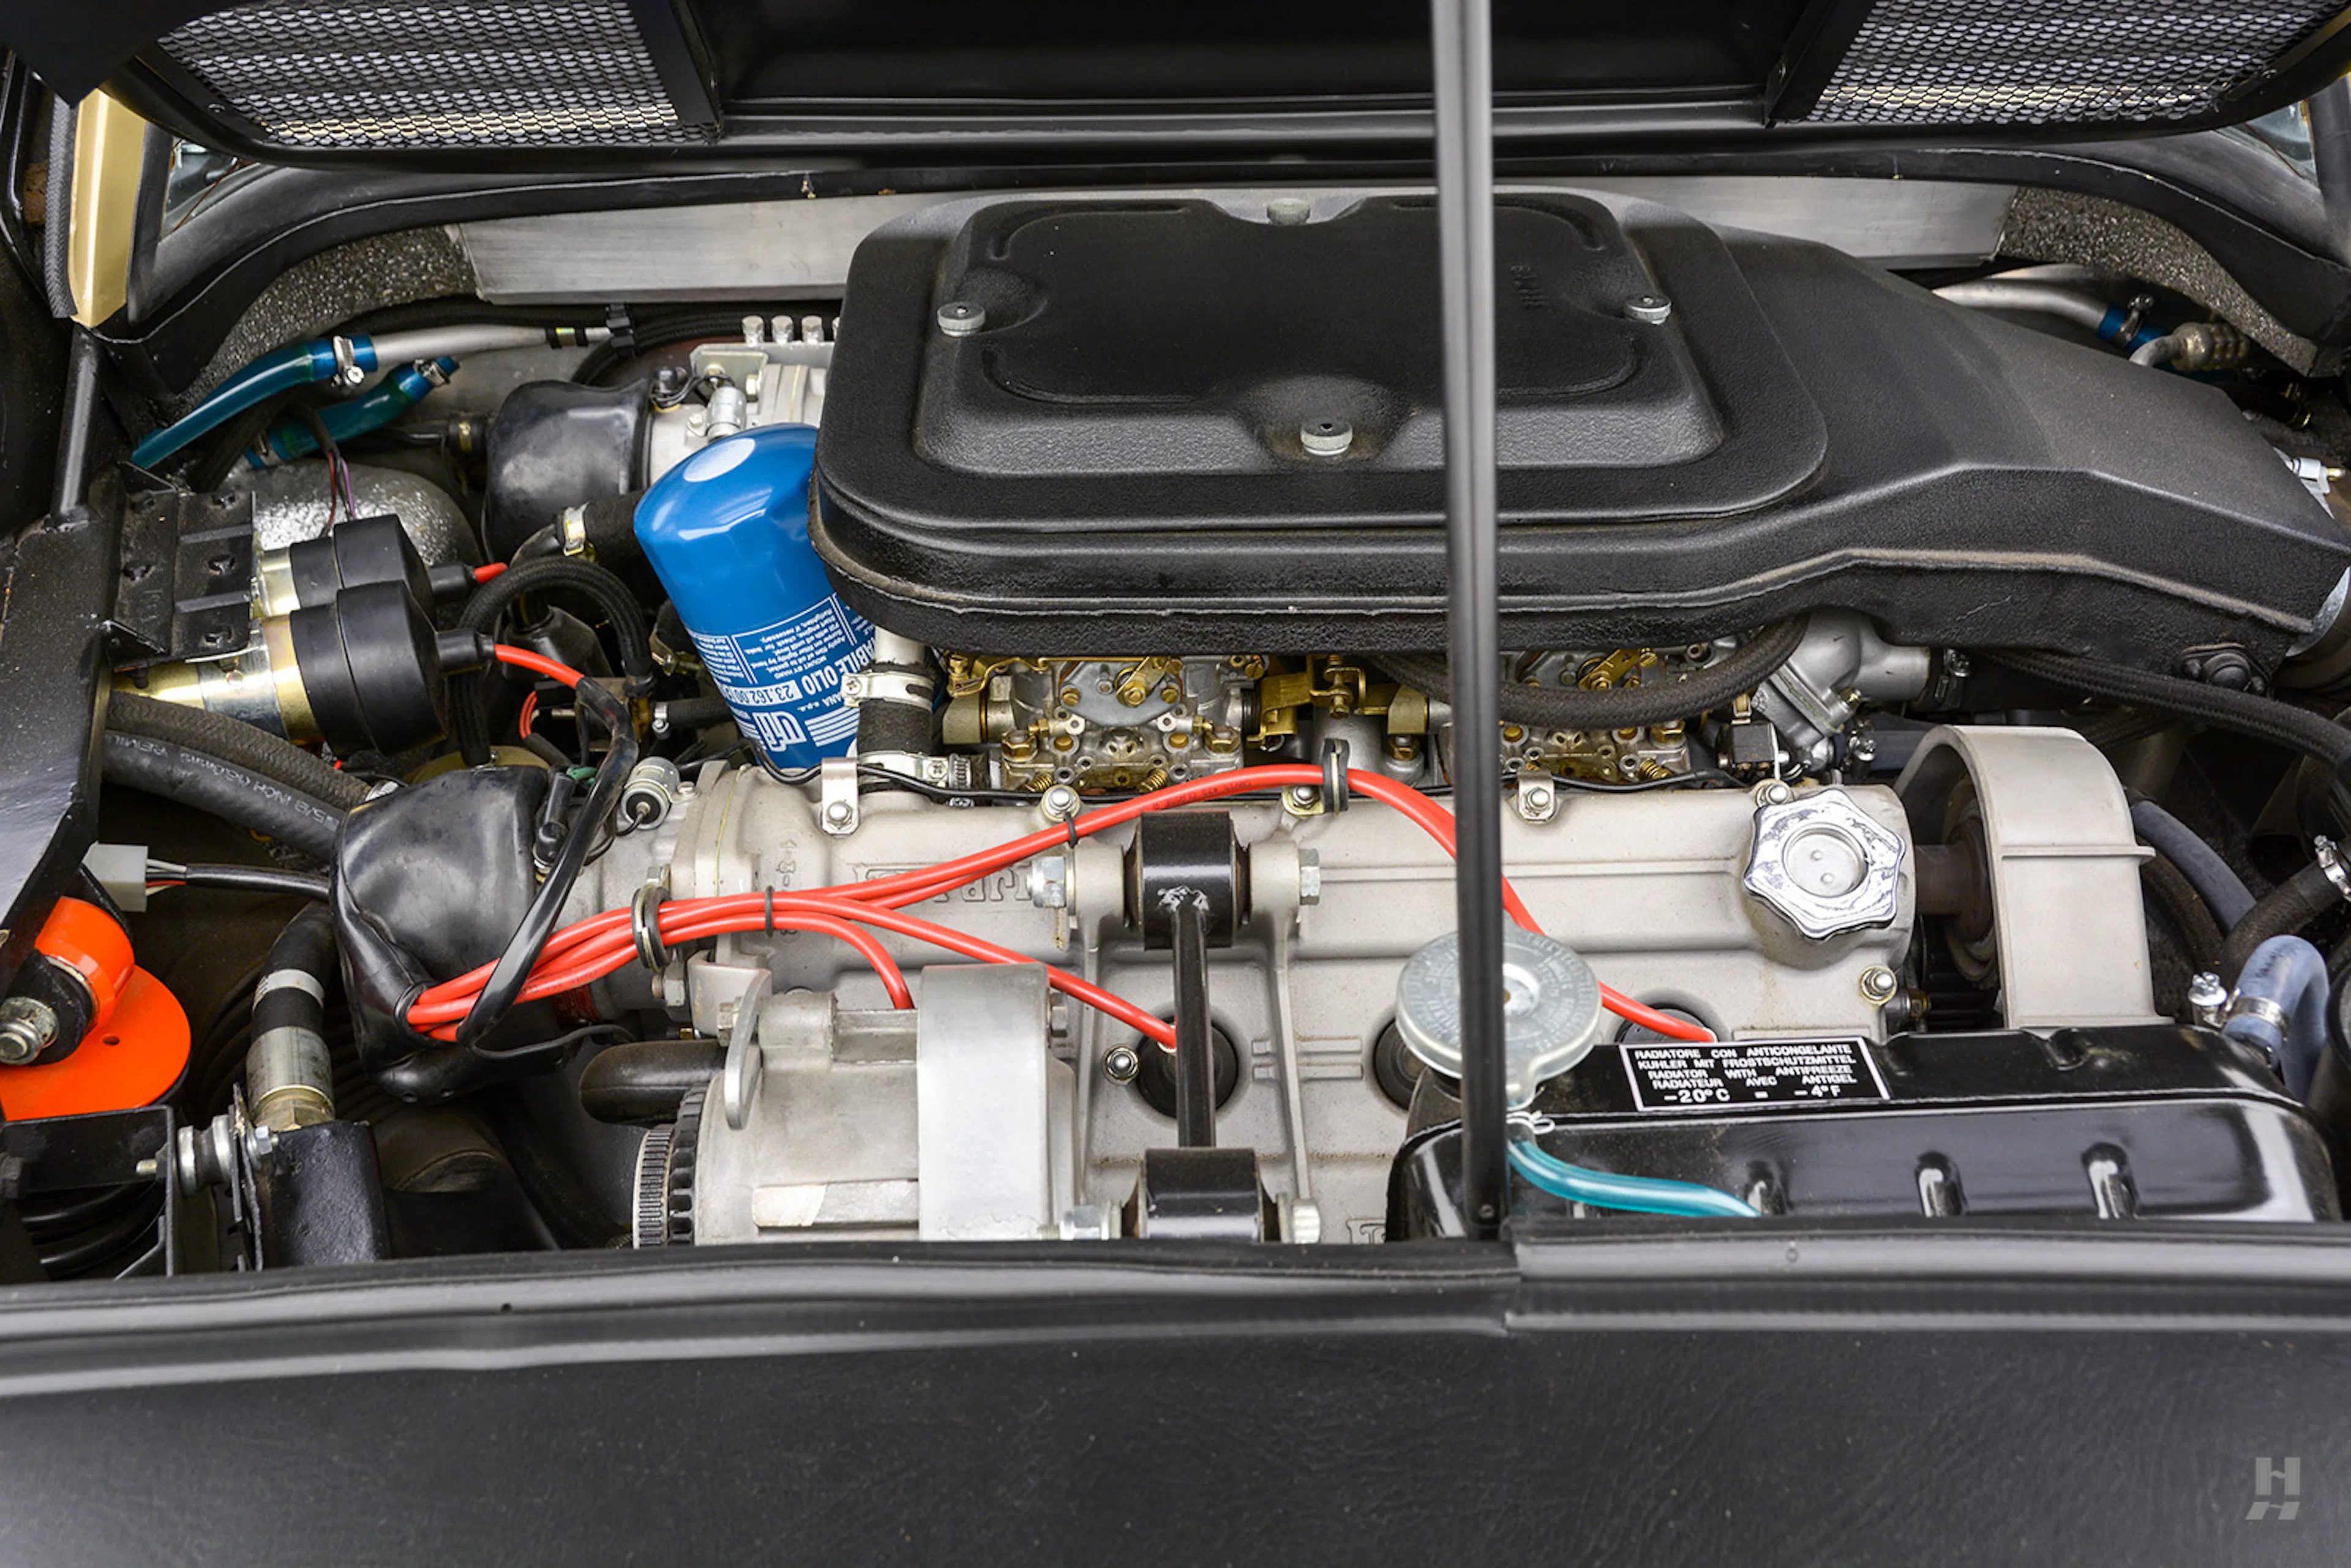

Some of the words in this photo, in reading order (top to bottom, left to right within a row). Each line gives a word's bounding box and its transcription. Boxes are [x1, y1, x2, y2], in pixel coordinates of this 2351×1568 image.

[802, 666, 838, 694] OLIO
[253, 781, 292, 806] INCH
[294, 799, 325, 824] 5/8
[1634, 1049, 1701, 1059] RADIATORE
[1711, 1048, 1738, 1059] CON
[1746, 1044, 1852, 1057] ANTICONGELANTE
[1693, 1059, 1714, 1068] MIT
[1722, 1054, 1856, 1068] FROSTSCHUTZMITTEL
[1648, 1069, 1708, 1080] RADIATOR
[1724, 1068, 1757, 1079] WITH
[1775, 1065, 1853, 1076] ANTIFREEZE
[1652, 1078, 1724, 1090] RADIATEUR
[1746, 1076, 1777, 1087] AVEC
[1802, 1073, 1858, 1085] ANTIGEL
